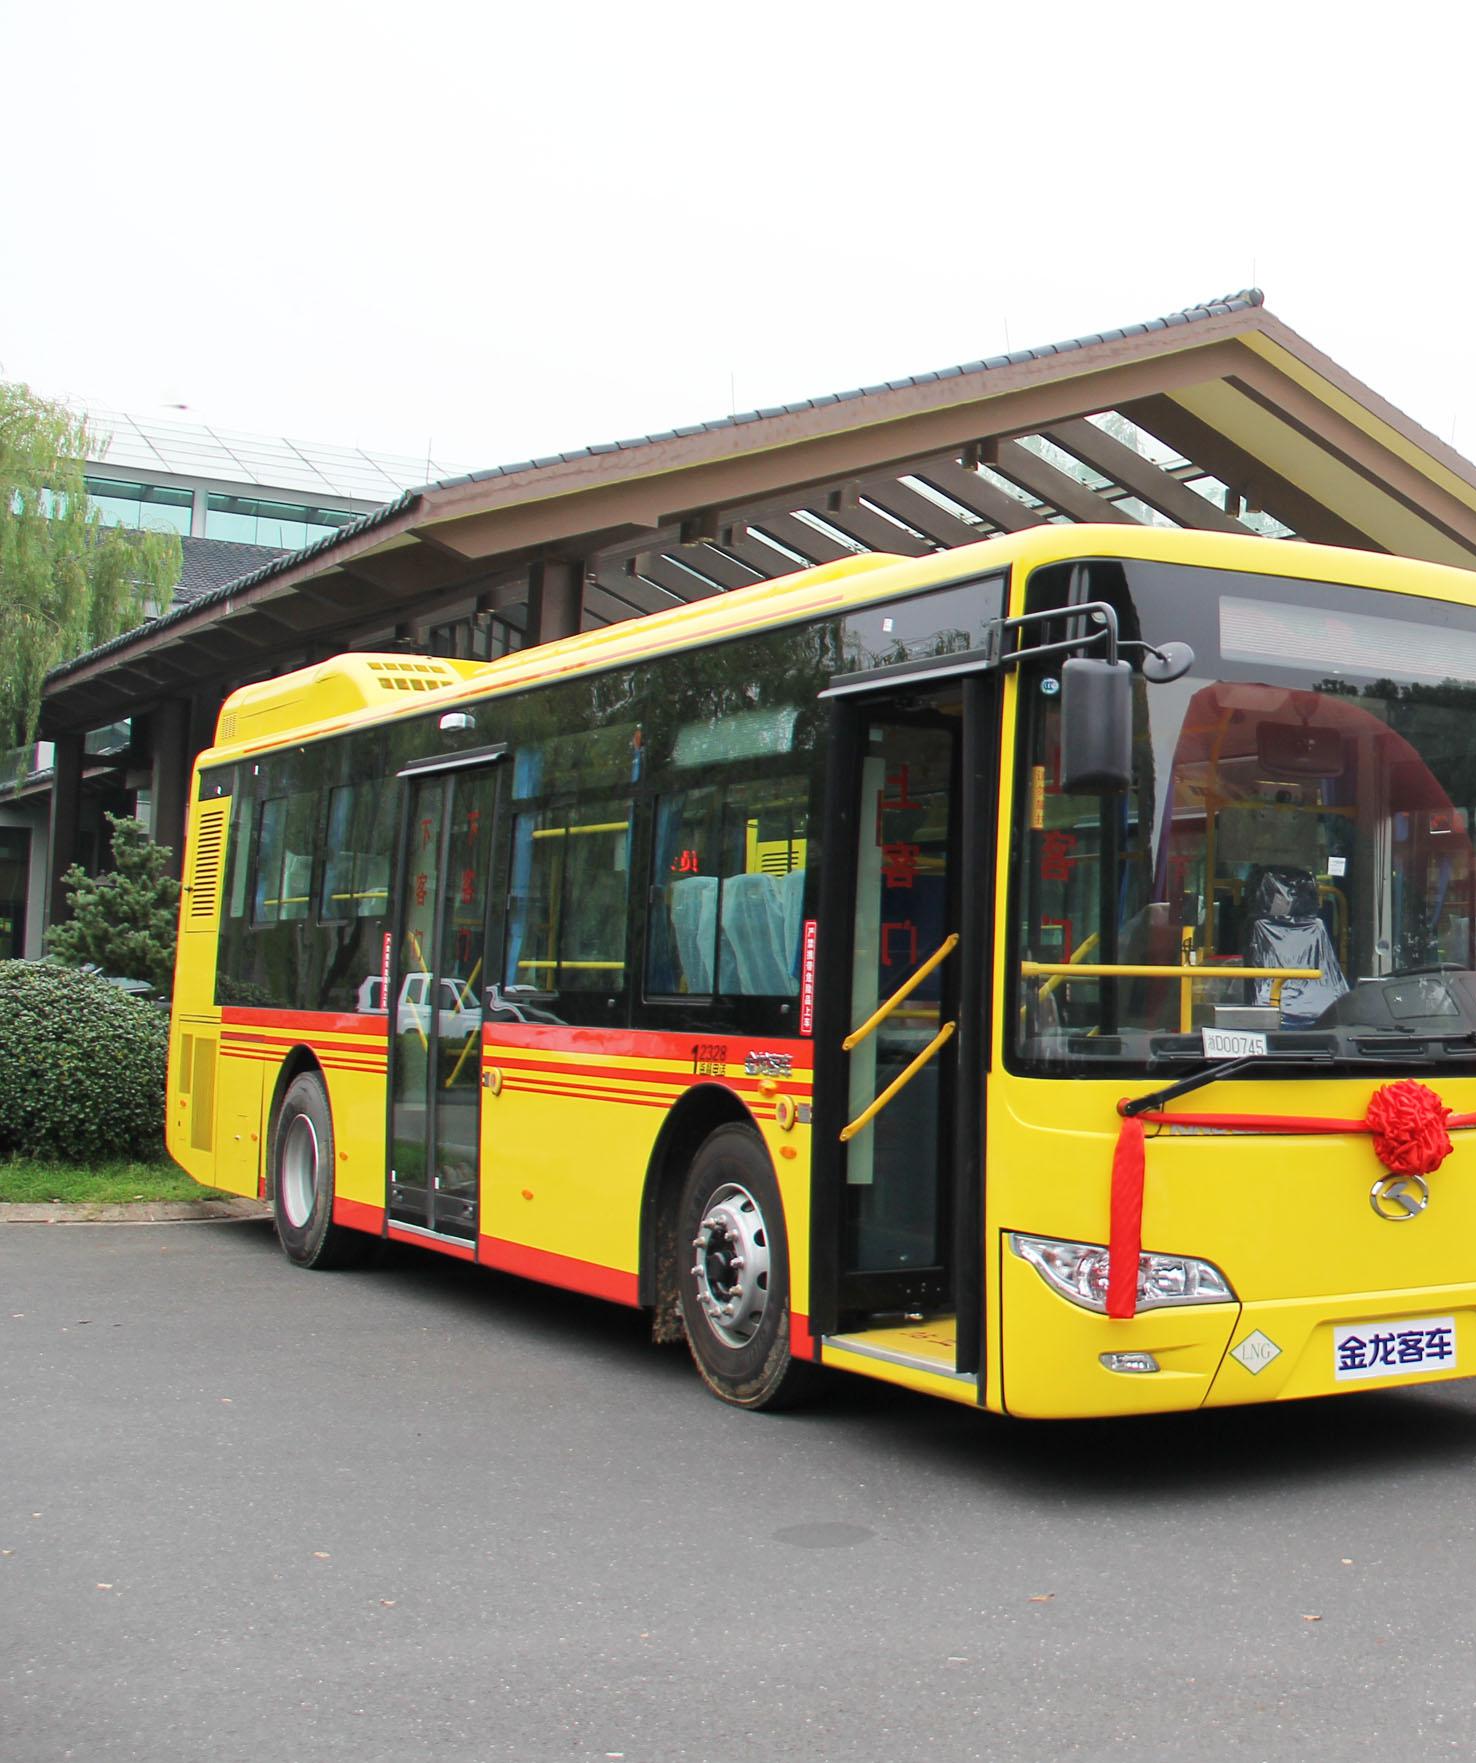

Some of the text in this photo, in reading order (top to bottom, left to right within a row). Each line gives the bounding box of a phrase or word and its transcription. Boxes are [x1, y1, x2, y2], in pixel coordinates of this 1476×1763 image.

[1241, 1341, 1271, 1361] LNG
[1338, 1328, 1453, 1372] 金龙客车
